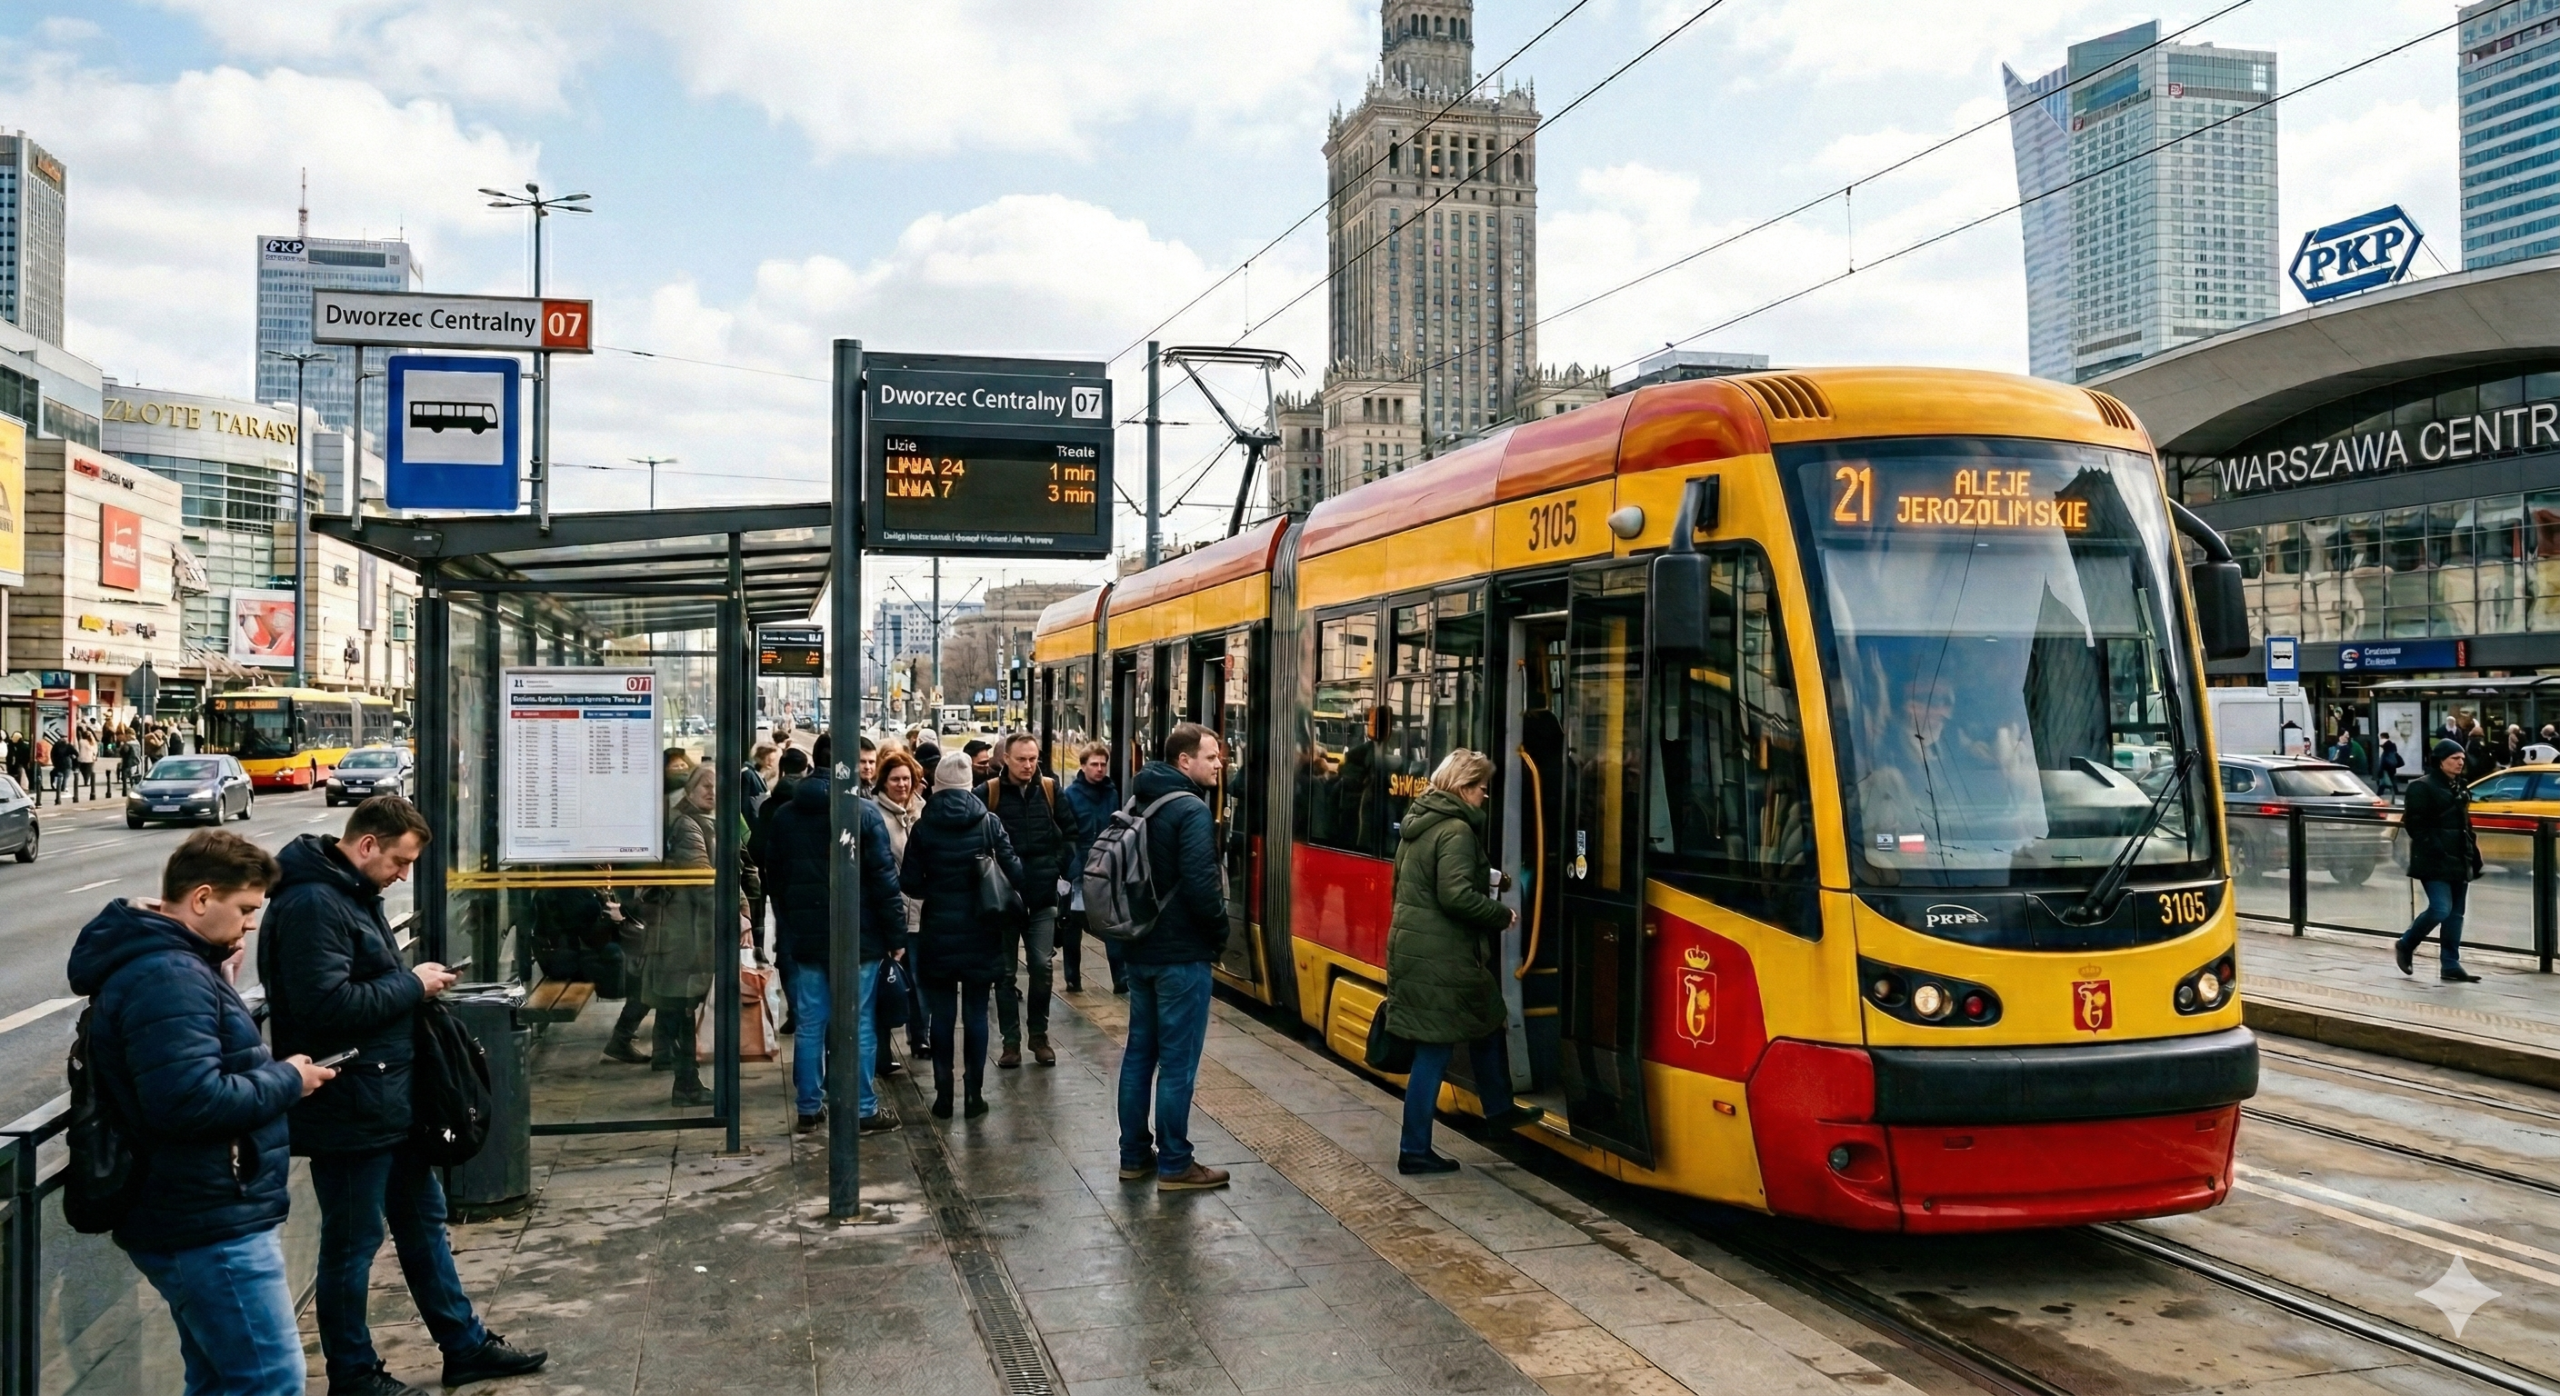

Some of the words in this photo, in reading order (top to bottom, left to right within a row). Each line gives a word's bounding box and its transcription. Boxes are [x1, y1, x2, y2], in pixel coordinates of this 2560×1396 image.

[269, 240, 304, 253] PKP
[2303, 226, 2405, 284] PKP
[326, 304, 423, 328] Dworzec
[429, 309, 536, 338] Centralny
[548, 312, 582, 337] 07
[881, 384, 968, 407] Dworzec
[972, 388, 1067, 417] Centralny
[1075, 393, 1100, 412] 07
[102, 398, 200, 430] ZŁOTE
[212, 409, 297, 445] TARASY
[2218, 429, 2409, 492] WARSZAWA
[2420, 403, 2560, 461] CENTR
[941, 458, 965, 477] 24
[1049, 462, 1058, 481] 1
[1064, 464, 1096, 482] min
[1955, 469, 2031, 497] ALEJE
[941, 480, 953, 499] 7
[1048, 484, 1060, 502] 3
[1064, 486, 1095, 503] min
[1834, 466, 1872, 522] 21
[1528, 499, 1577, 551] 3105
[1897, 496, 2088, 528] JEROZOLIMSKIE
[2159, 891, 2206, 925] 3105
